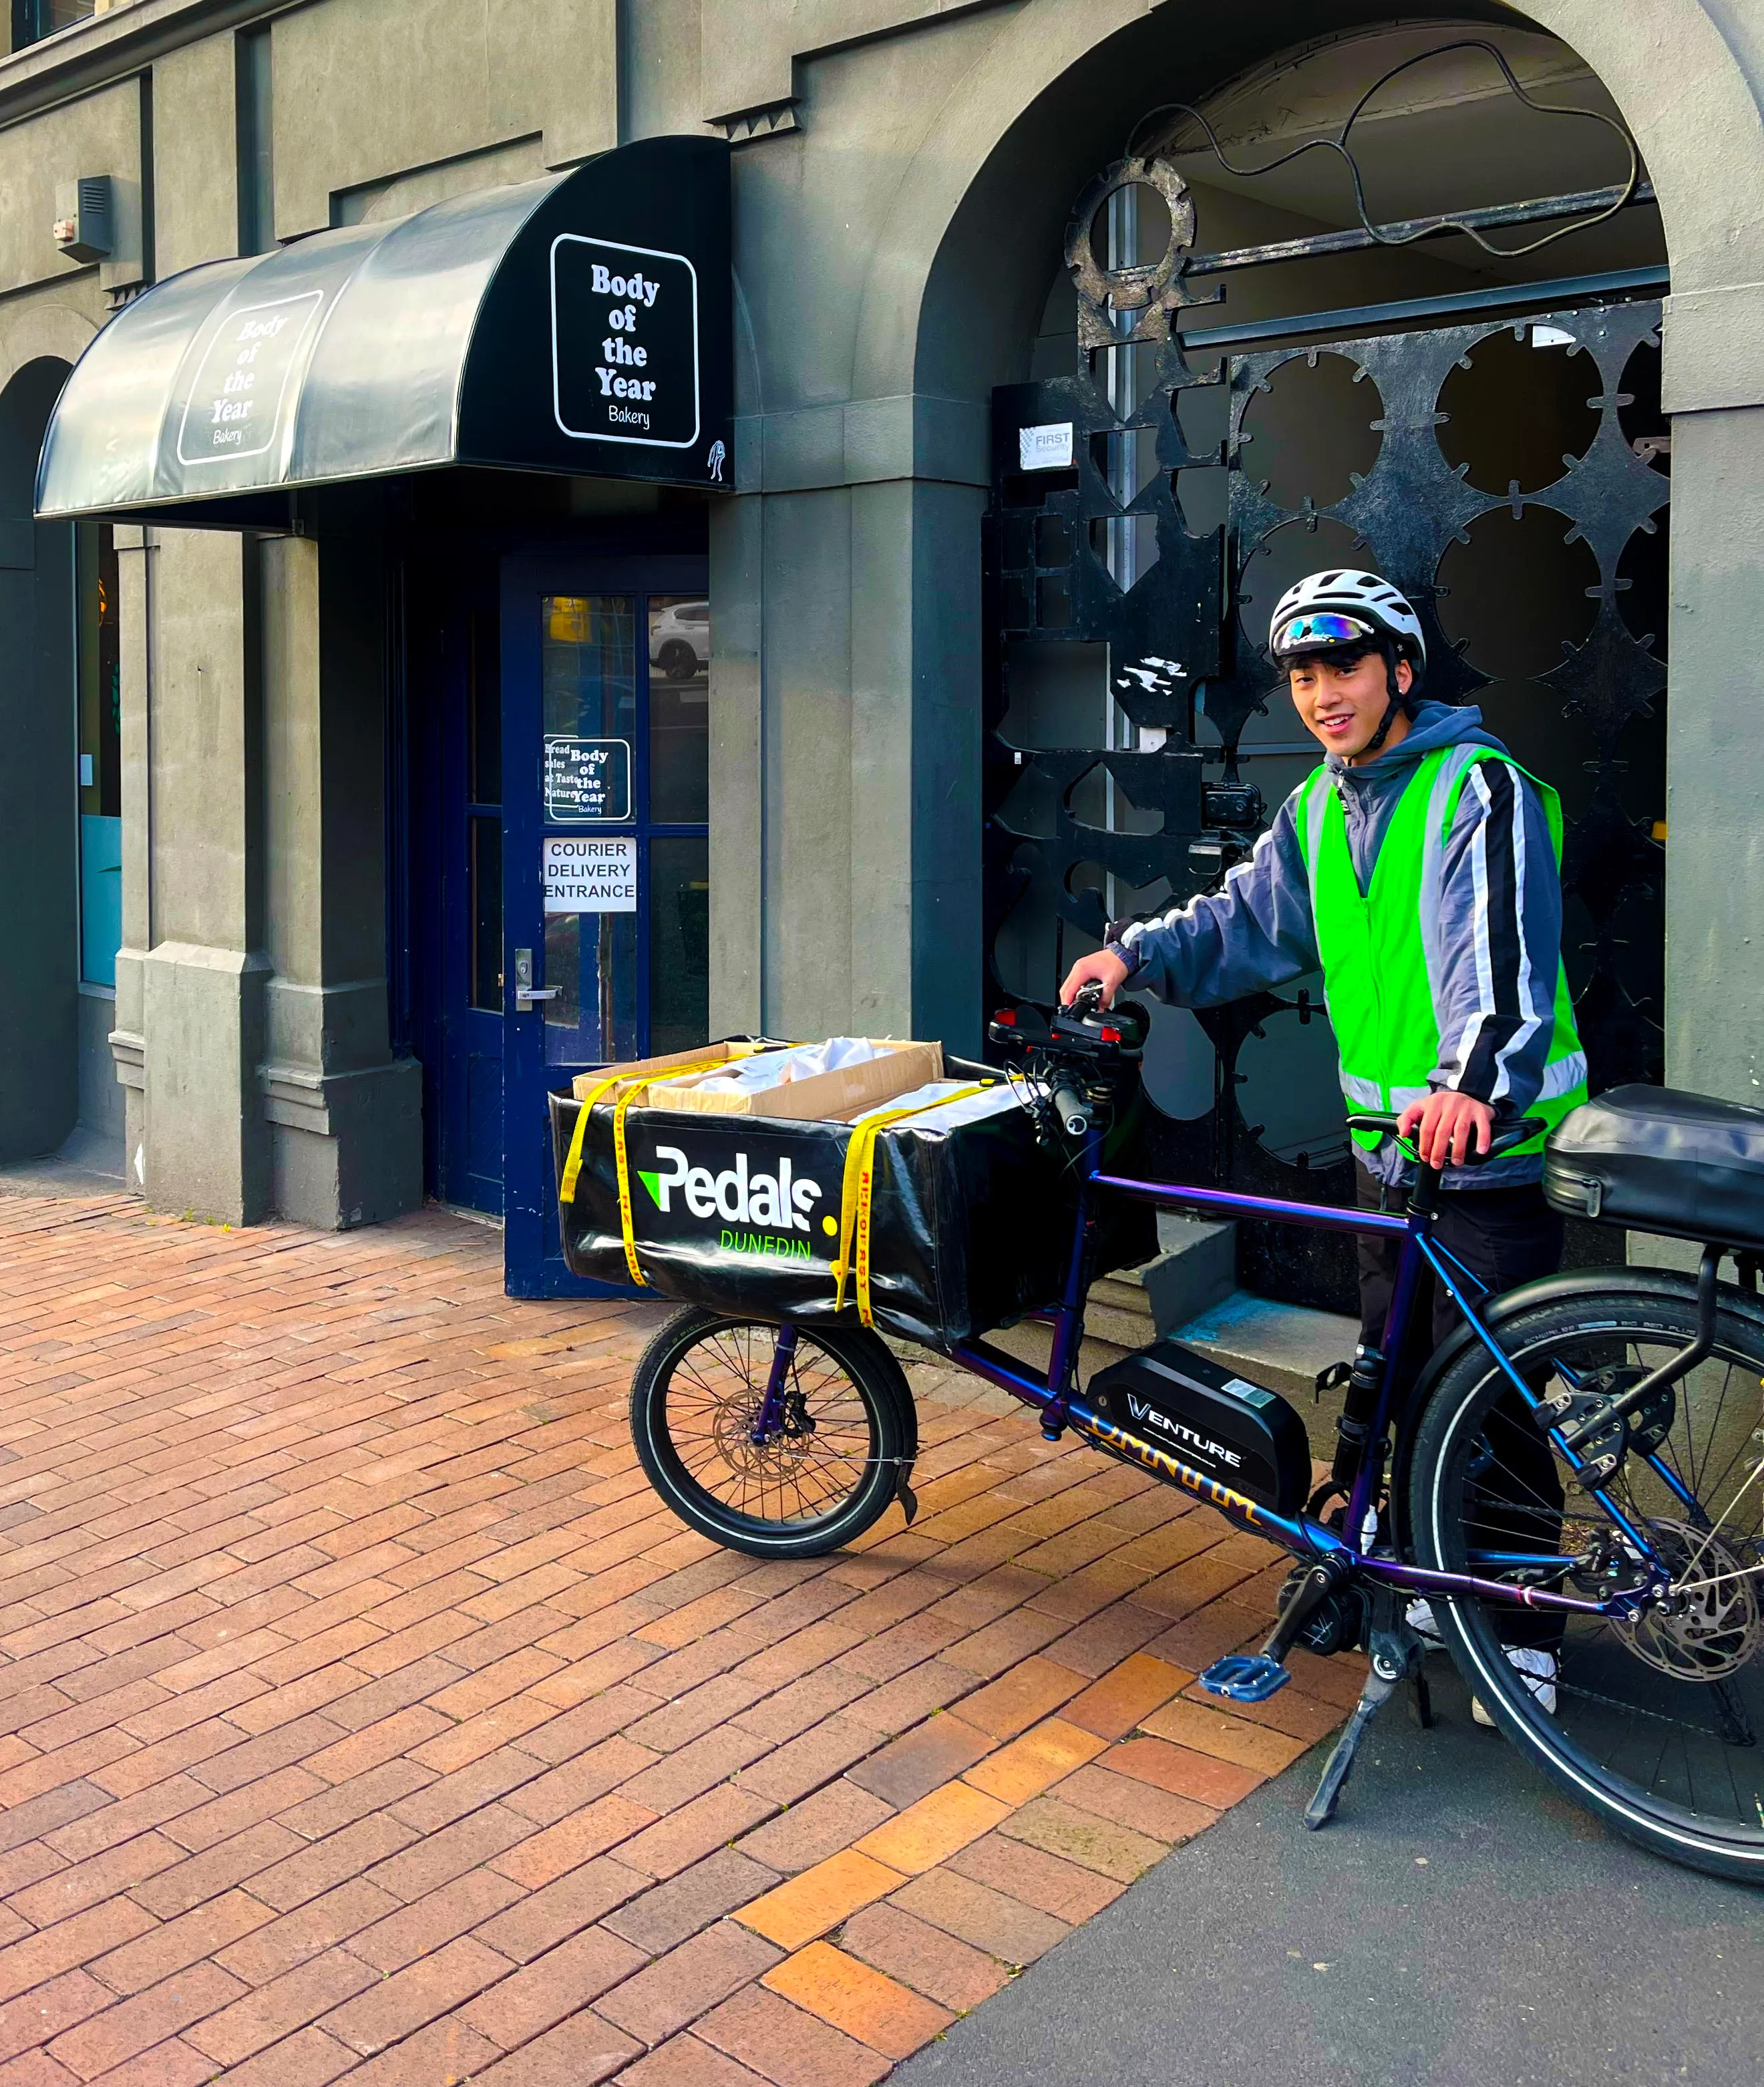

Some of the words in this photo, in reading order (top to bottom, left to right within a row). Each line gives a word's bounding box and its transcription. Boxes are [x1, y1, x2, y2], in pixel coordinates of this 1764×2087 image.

[591, 264, 660, 307] Body
[608, 304, 637, 332] of
[236, 315, 290, 341] Body
[236, 341, 262, 365] of
[602, 337, 647, 367] the
[223, 369, 254, 394] the
[594, 367, 656, 401] Year
[212, 398, 253, 423] Year
[608, 405, 650, 430] Bakery
[213, 428, 242, 445] Bakery
[1036, 432, 1070, 446] FIRST
[1036, 443, 1069, 453] Security
[544, 744, 570, 754] Bread
[570, 749, 608, 764] Body
[579, 763, 595, 775] of
[555, 773, 578, 784] Taste
[576, 777, 601, 789] the
[544, 787, 575, 798] Nature
[574, 790, 606, 802] Year
[578, 805, 602, 814] Bakery
[551, 843, 627, 856] COURIER
[548, 864, 631, 877] DELIVERY
[544, 885, 635, 898] ENTRANCE
[720, 1229, 811, 1261] DUNEDIN
[1668, 1325, 1697, 1335] PLUS
[1127, 1393, 1242, 1468] VENTURE
